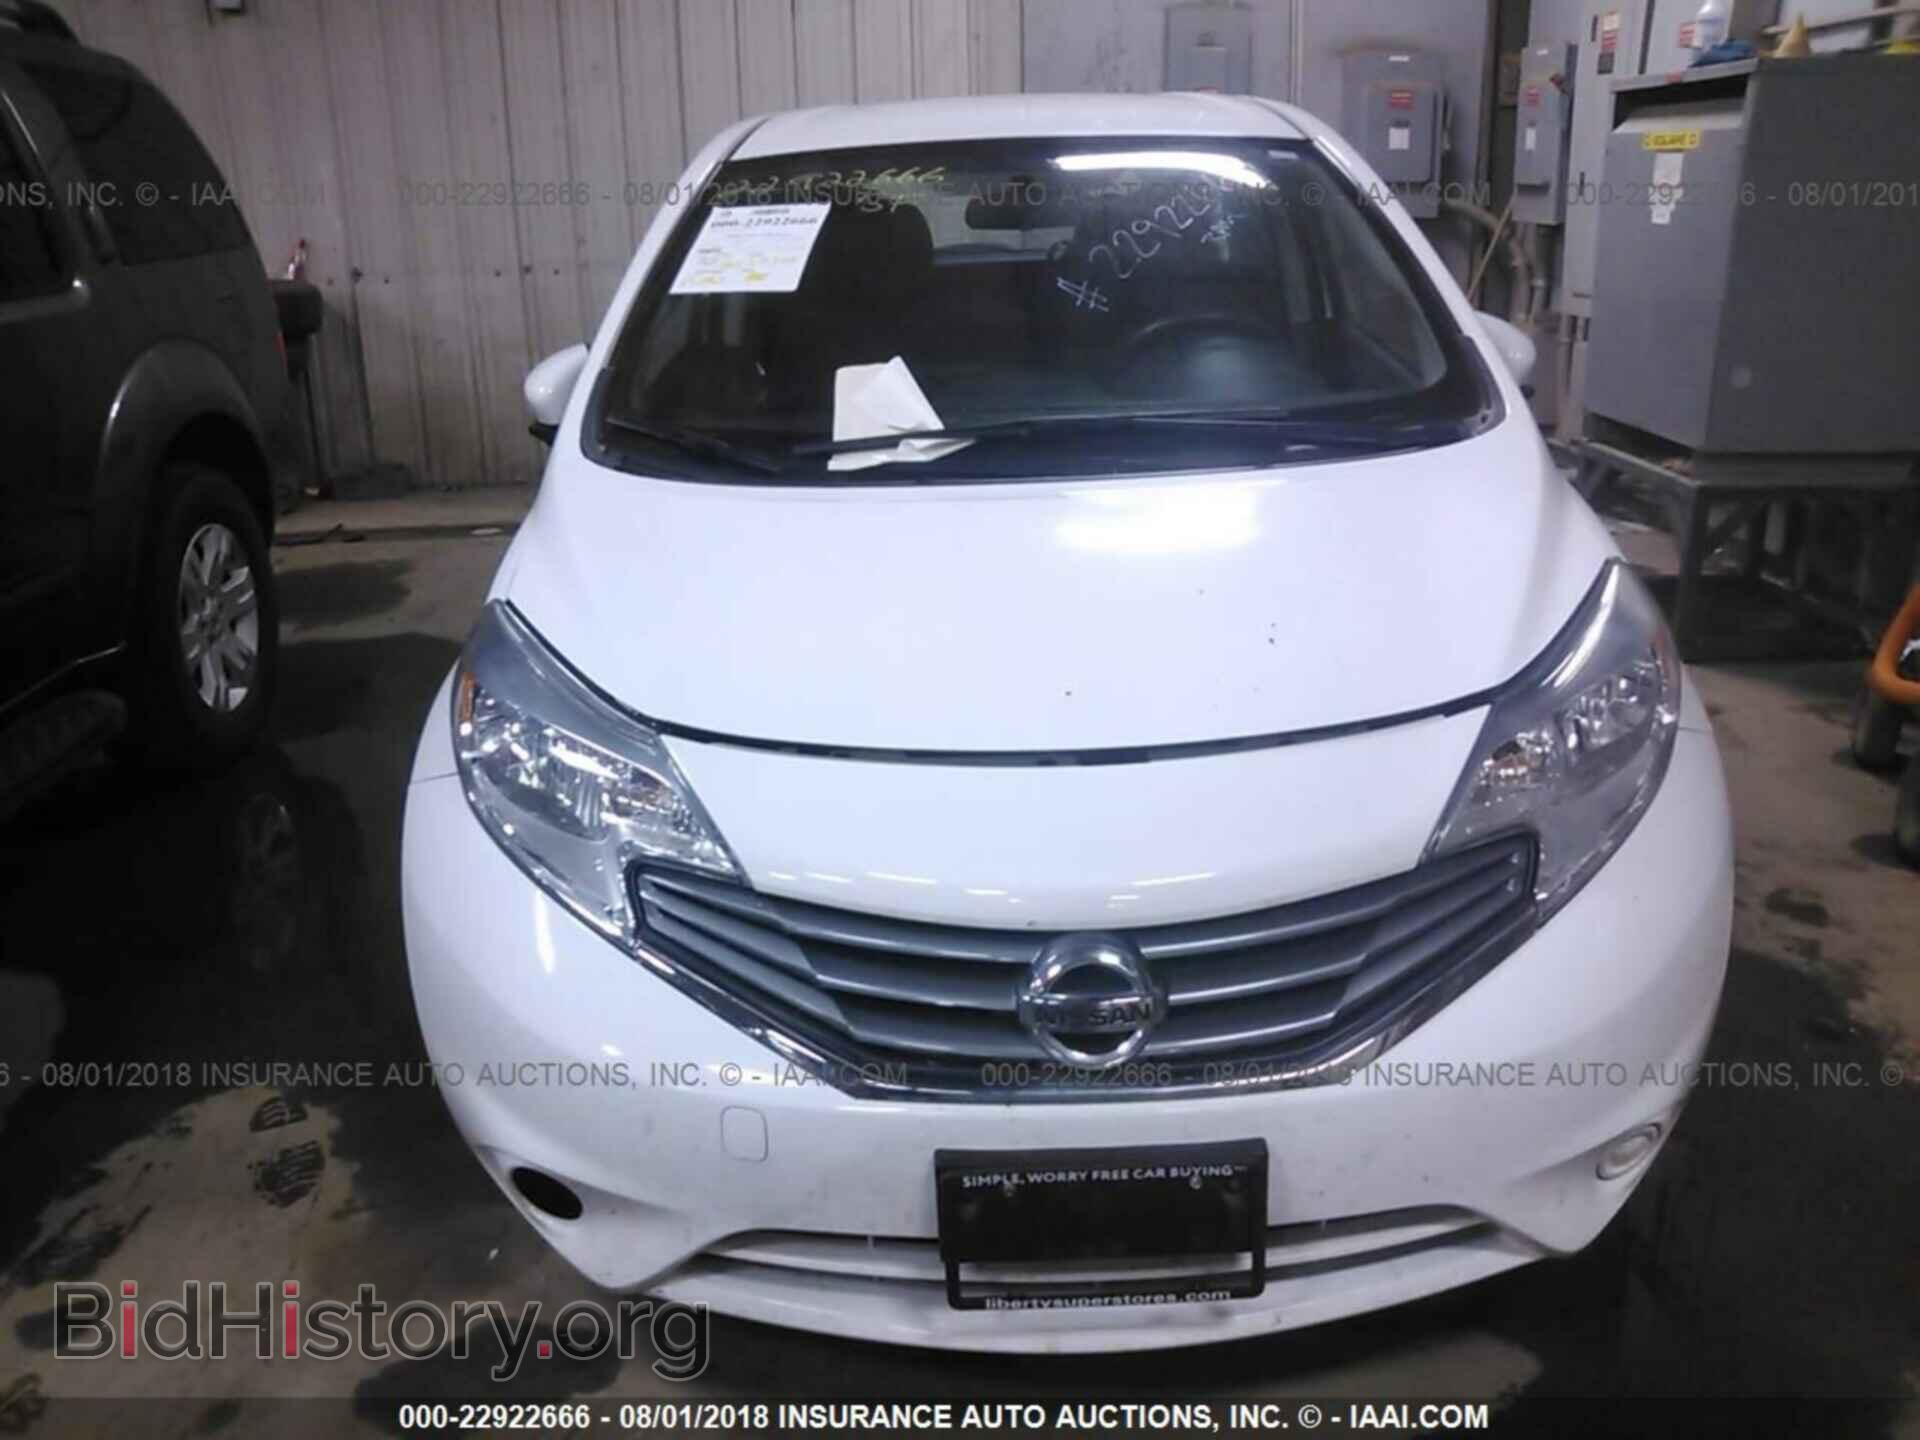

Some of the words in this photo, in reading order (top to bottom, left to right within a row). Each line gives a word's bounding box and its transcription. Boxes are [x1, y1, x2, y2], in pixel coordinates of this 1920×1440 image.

[1028, 1170, 1087, 1184] WORRY
[1092, 1168, 1129, 1182] FREE
[1133, 1166, 1166, 1180] CAR
[985, 1289, 1231, 1309] libertysuperstores.com
